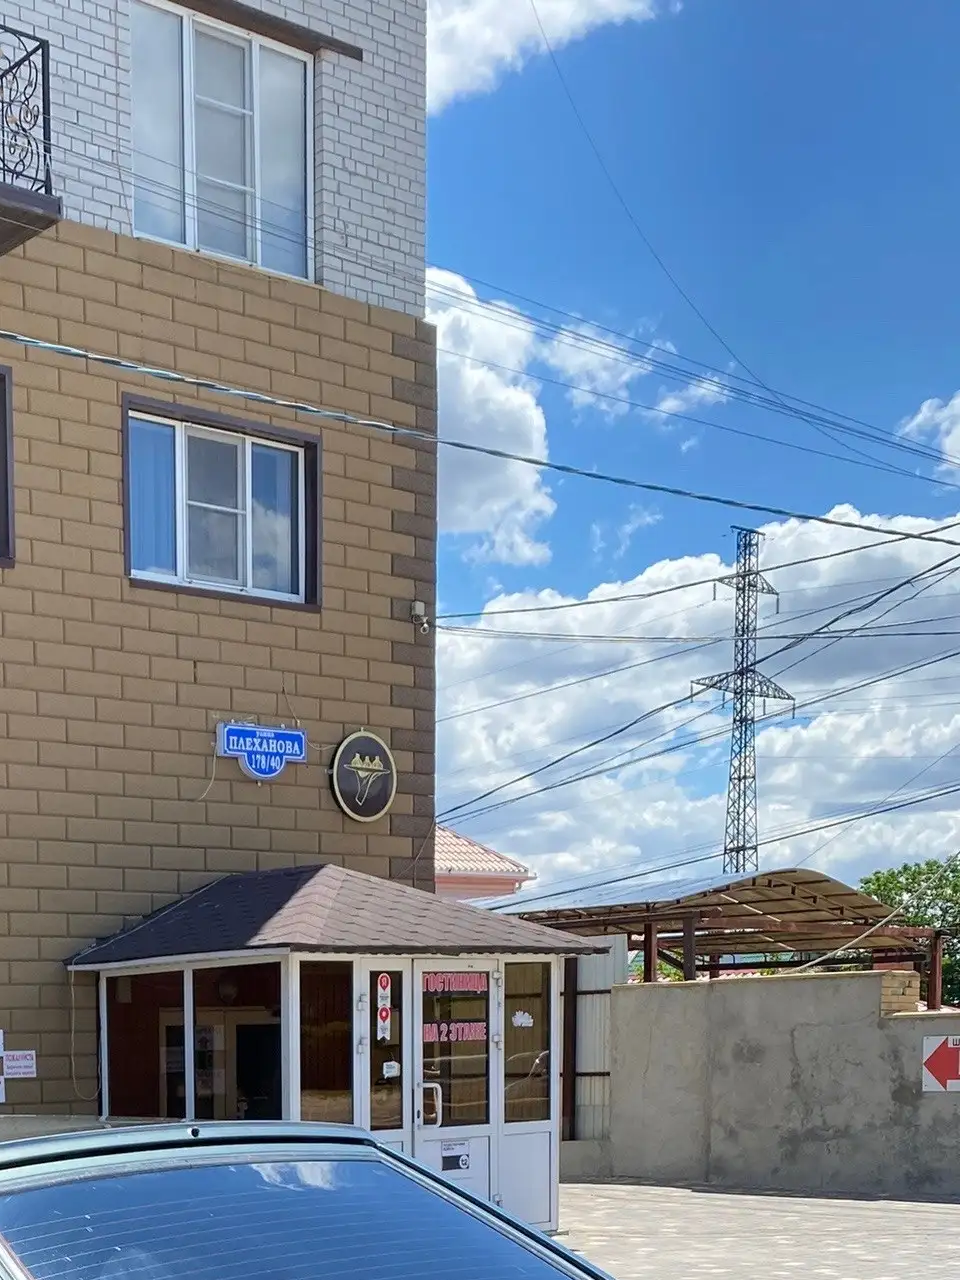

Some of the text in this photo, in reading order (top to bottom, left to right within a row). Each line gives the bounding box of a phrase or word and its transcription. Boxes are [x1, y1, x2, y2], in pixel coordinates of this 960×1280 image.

[229, 736, 300, 755] ПЛЕХАНОВА
[251, 754, 281, 772] 178/40
[422, 973, 488, 994] ГОСТИНИЦА
[423, 1022, 487, 1042] НА 2 ЭТАЖЕ
